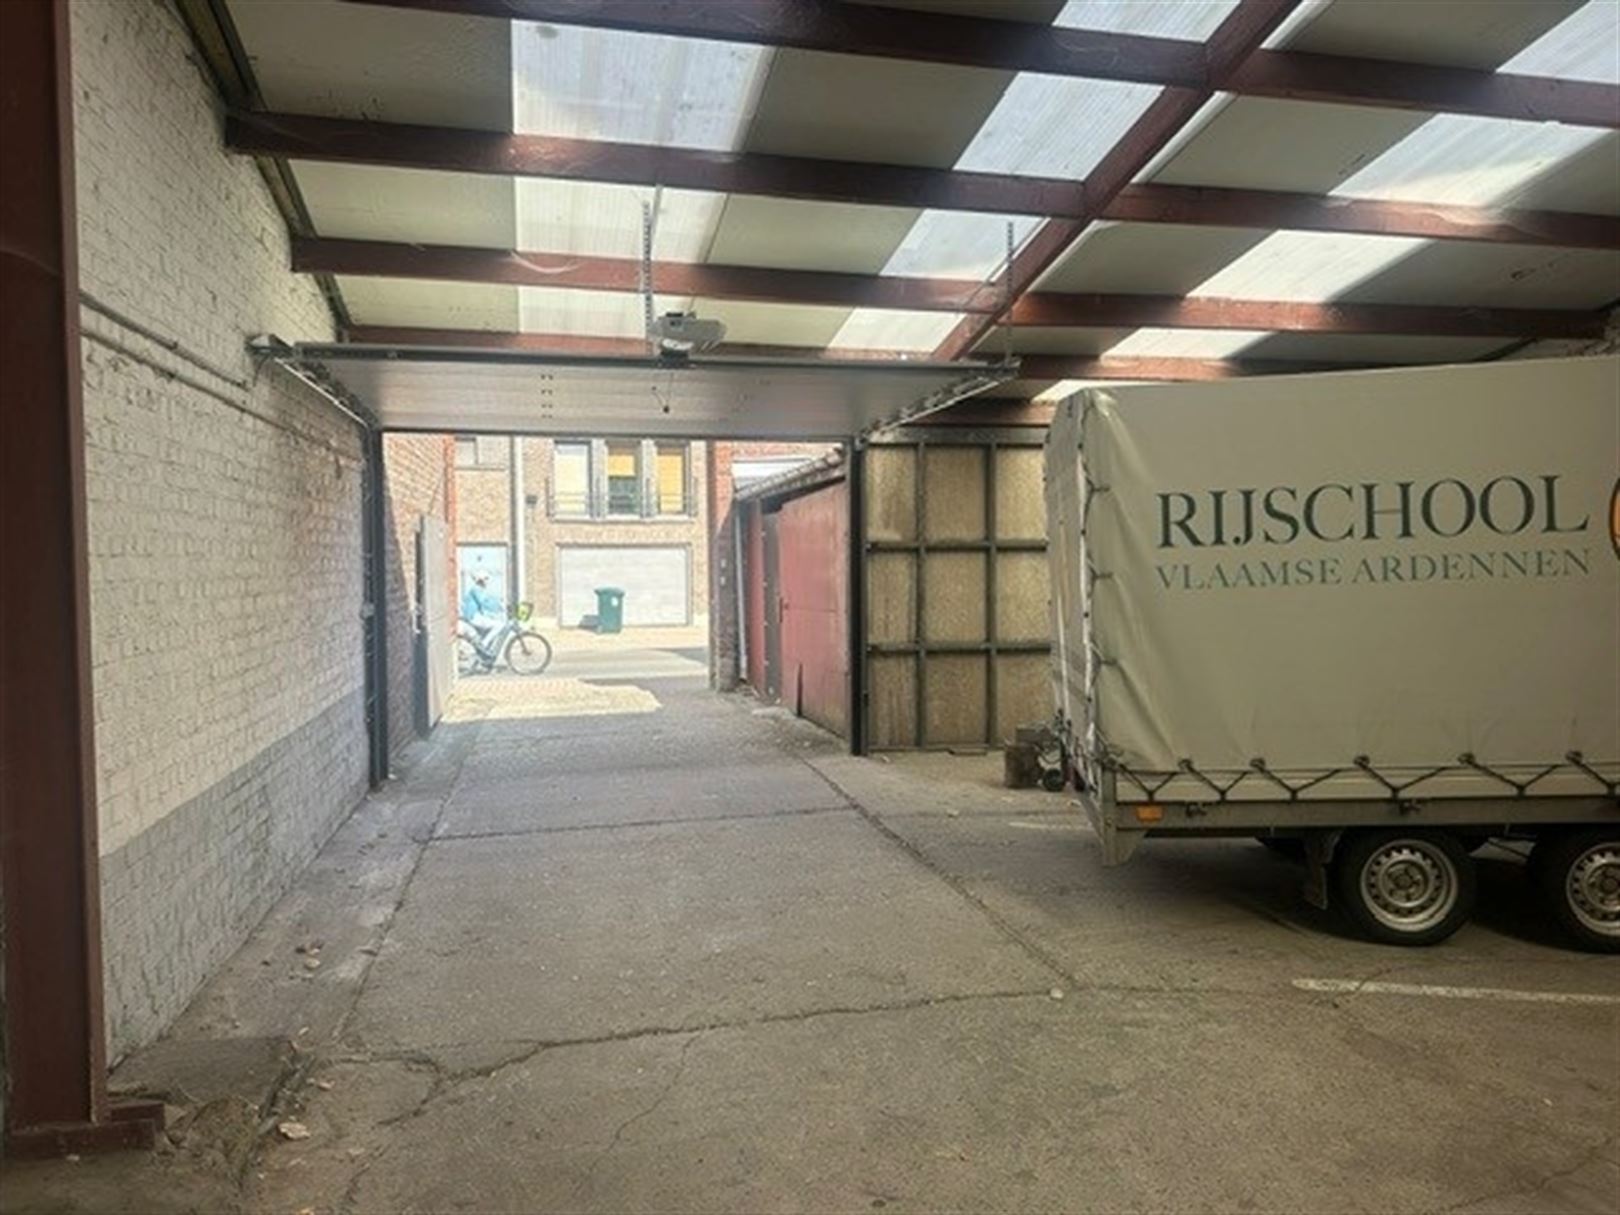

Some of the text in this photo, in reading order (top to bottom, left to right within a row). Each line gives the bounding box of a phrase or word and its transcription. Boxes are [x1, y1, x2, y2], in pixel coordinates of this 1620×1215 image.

[1157, 474, 1590, 549] RIJSCHOOL
[1155, 548, 1591, 591] VLAAMSE ARDENNEN
